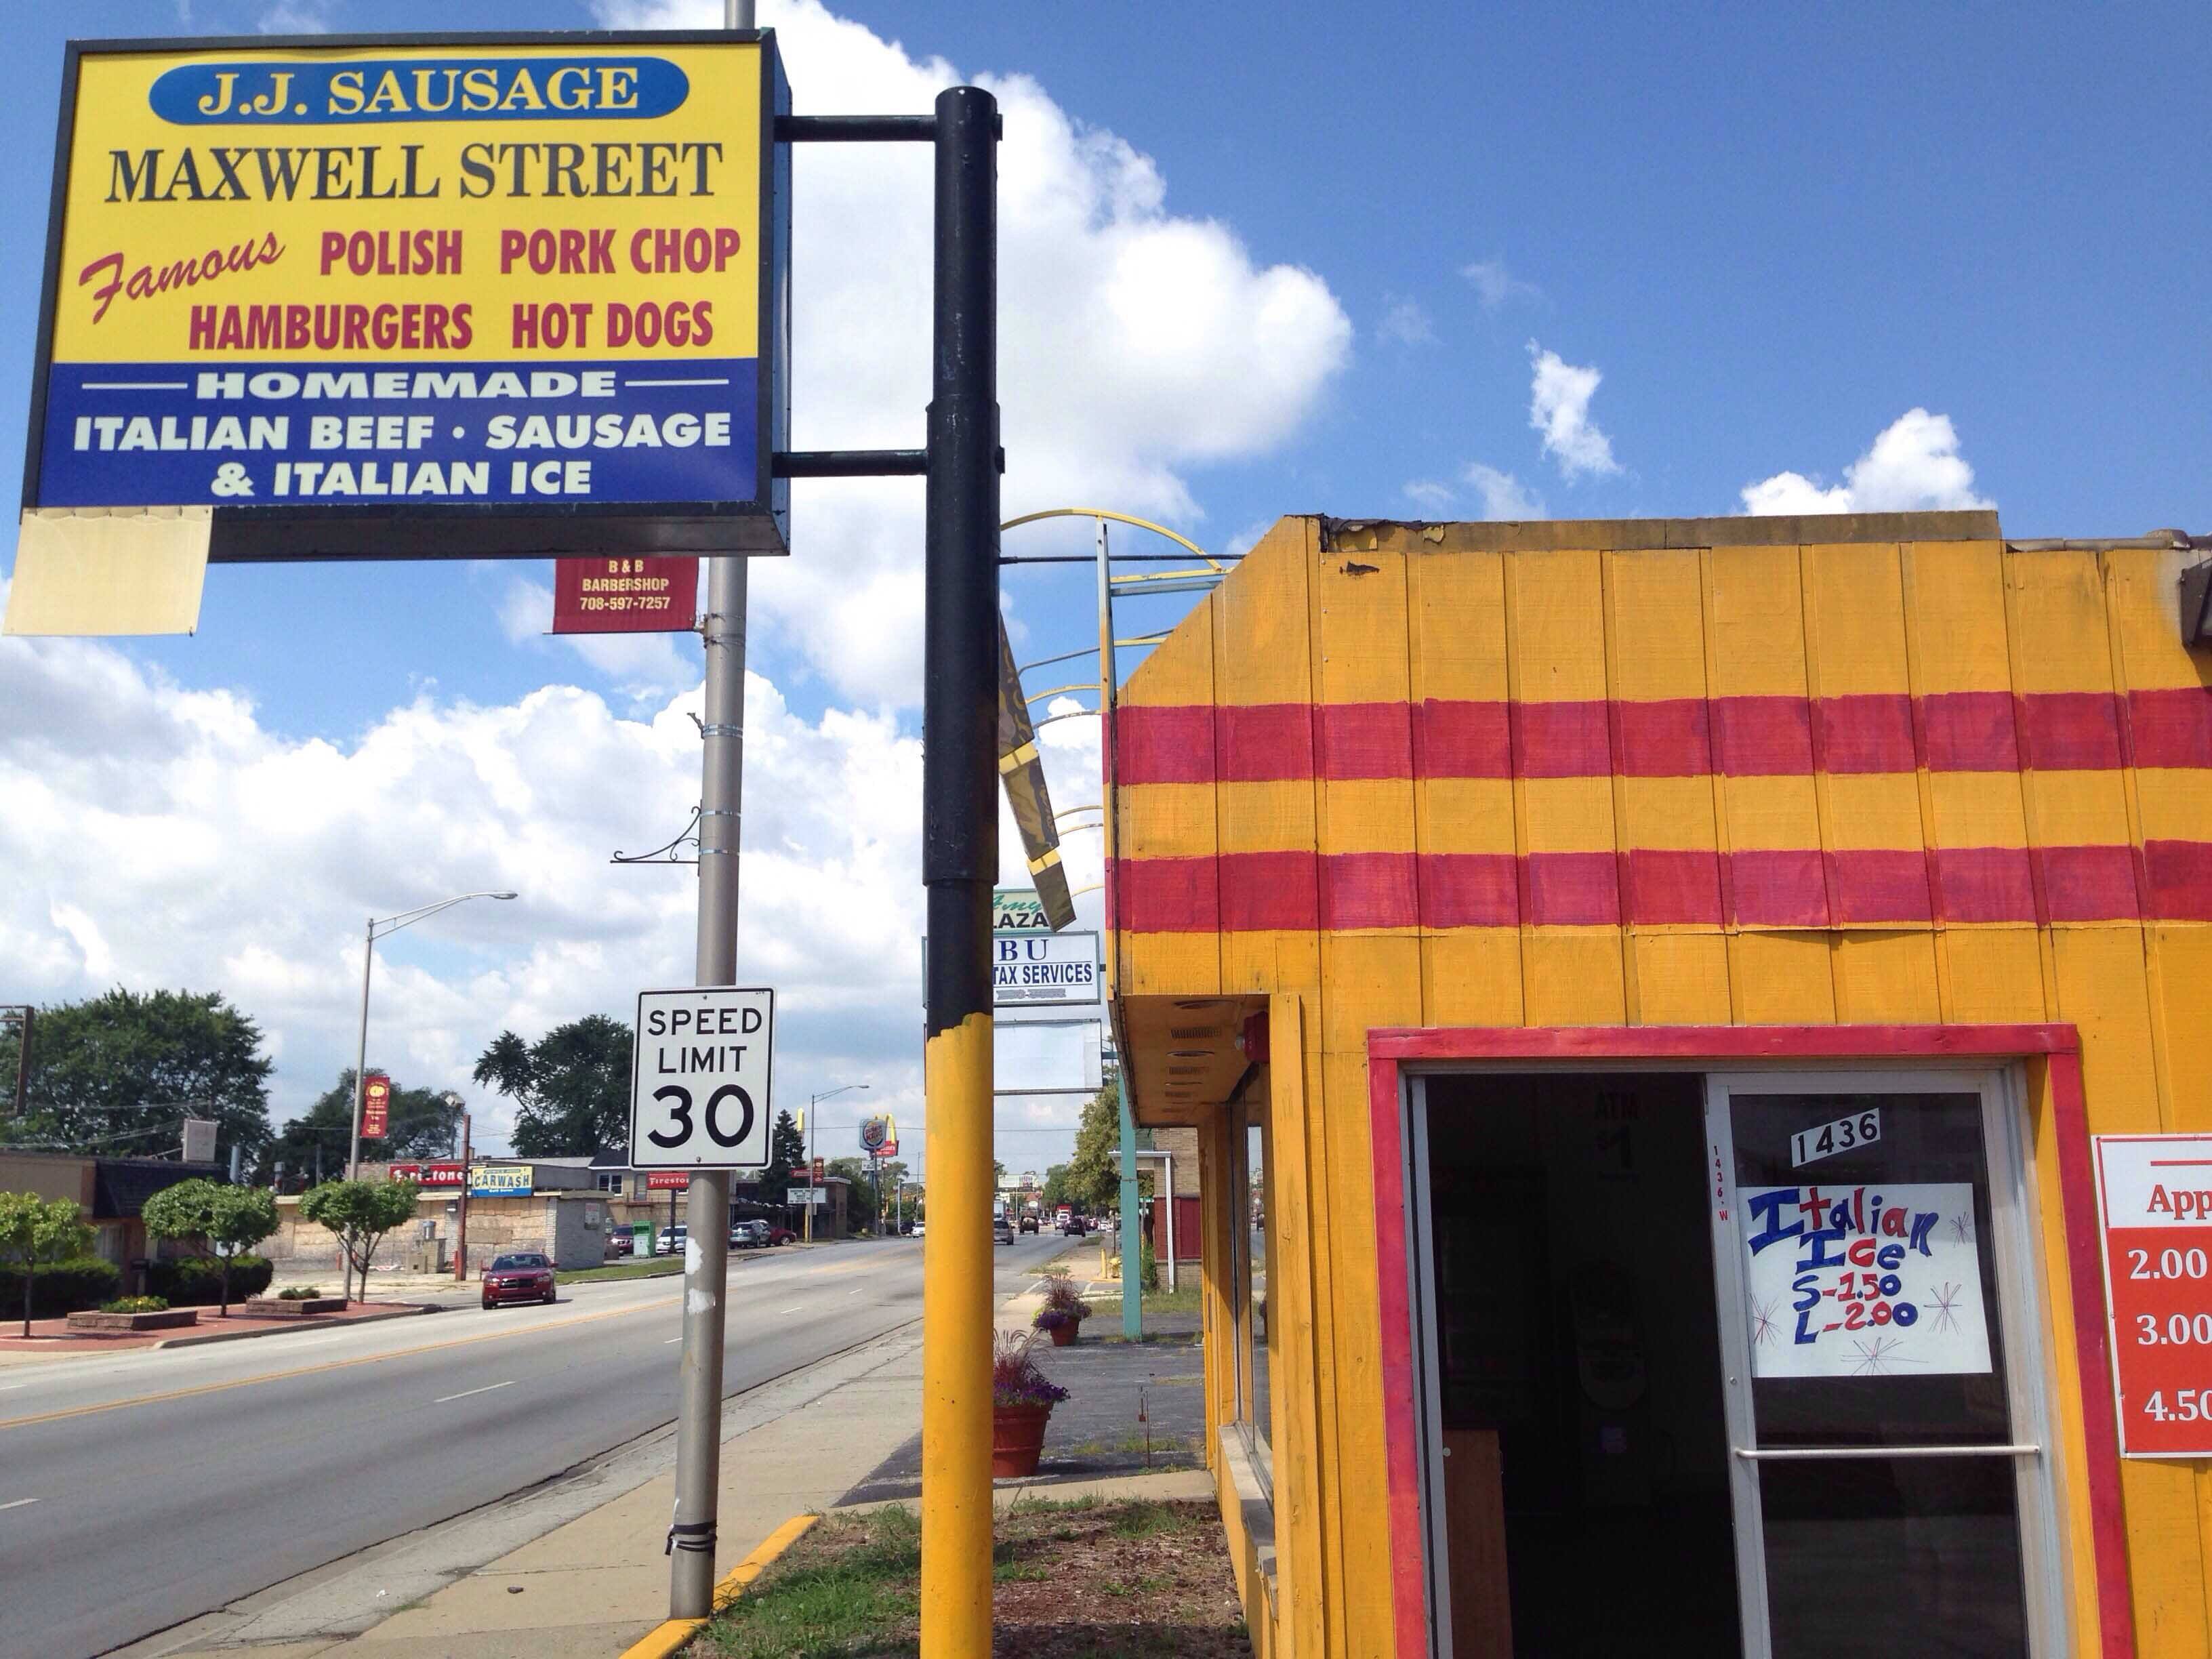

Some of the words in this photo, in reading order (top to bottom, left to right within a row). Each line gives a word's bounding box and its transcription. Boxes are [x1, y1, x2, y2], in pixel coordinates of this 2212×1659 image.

[199, 73, 307, 117] J.J.
[329, 66, 638, 115] SAUSAGE
[104, 146, 440, 203] MAXWELL
[459, 143, 723, 199] STREET
[78, 232, 286, 323] Famous
[319, 230, 463, 276] POLISH
[501, 229, 615, 274] PORK
[631, 228, 741, 272] CHOP
[188, 304, 473, 350] HAMBURGERS
[512, 303, 594, 348] HOT
[607, 301, 713, 347] DOGS
[196, 371, 617, 398] HOMEMADE
[73, 417, 287, 451] ITALIAN
[310, 415, 434, 450] BEEF
[487, 412, 731, 447] SAUSAGE
[210, 464, 255, 496] &
[273, 462, 490, 496] ITALIAN
[510, 460, 592, 495] ICE
[609, 560, 618, 573] B
[621, 560, 630, 573] &
[635, 560, 644, 572] B
[582, 578, 670, 592] BARBERSHOP
[580, 596, 671, 610] 708-597-7257
[994, 912, 1049, 928] AZA
[994, 966, 1017, 985] TAX
[1023, 964, 1092, 983] SERVICES
[647, 1008, 762, 1036] SPEED
[659, 1046, 747, 1073] LIMIT
[647, 1084, 754, 1148] 30
[1798, 1113, 1878, 1163] 1436
[474, 1174, 529, 1187] CARWASH
[649, 1177, 689, 1185] Firesto
[1719, 1210, 1729, 1221] W
[1748, 1187, 1939, 1257] Italian
[1795, 1229, 1906, 1275] Ice
[2127, 1248, 2207, 1280] 2.00
[2135, 1313, 2212, 1345] 3.00
[2144, 1389, 2212, 1422] 4.50
